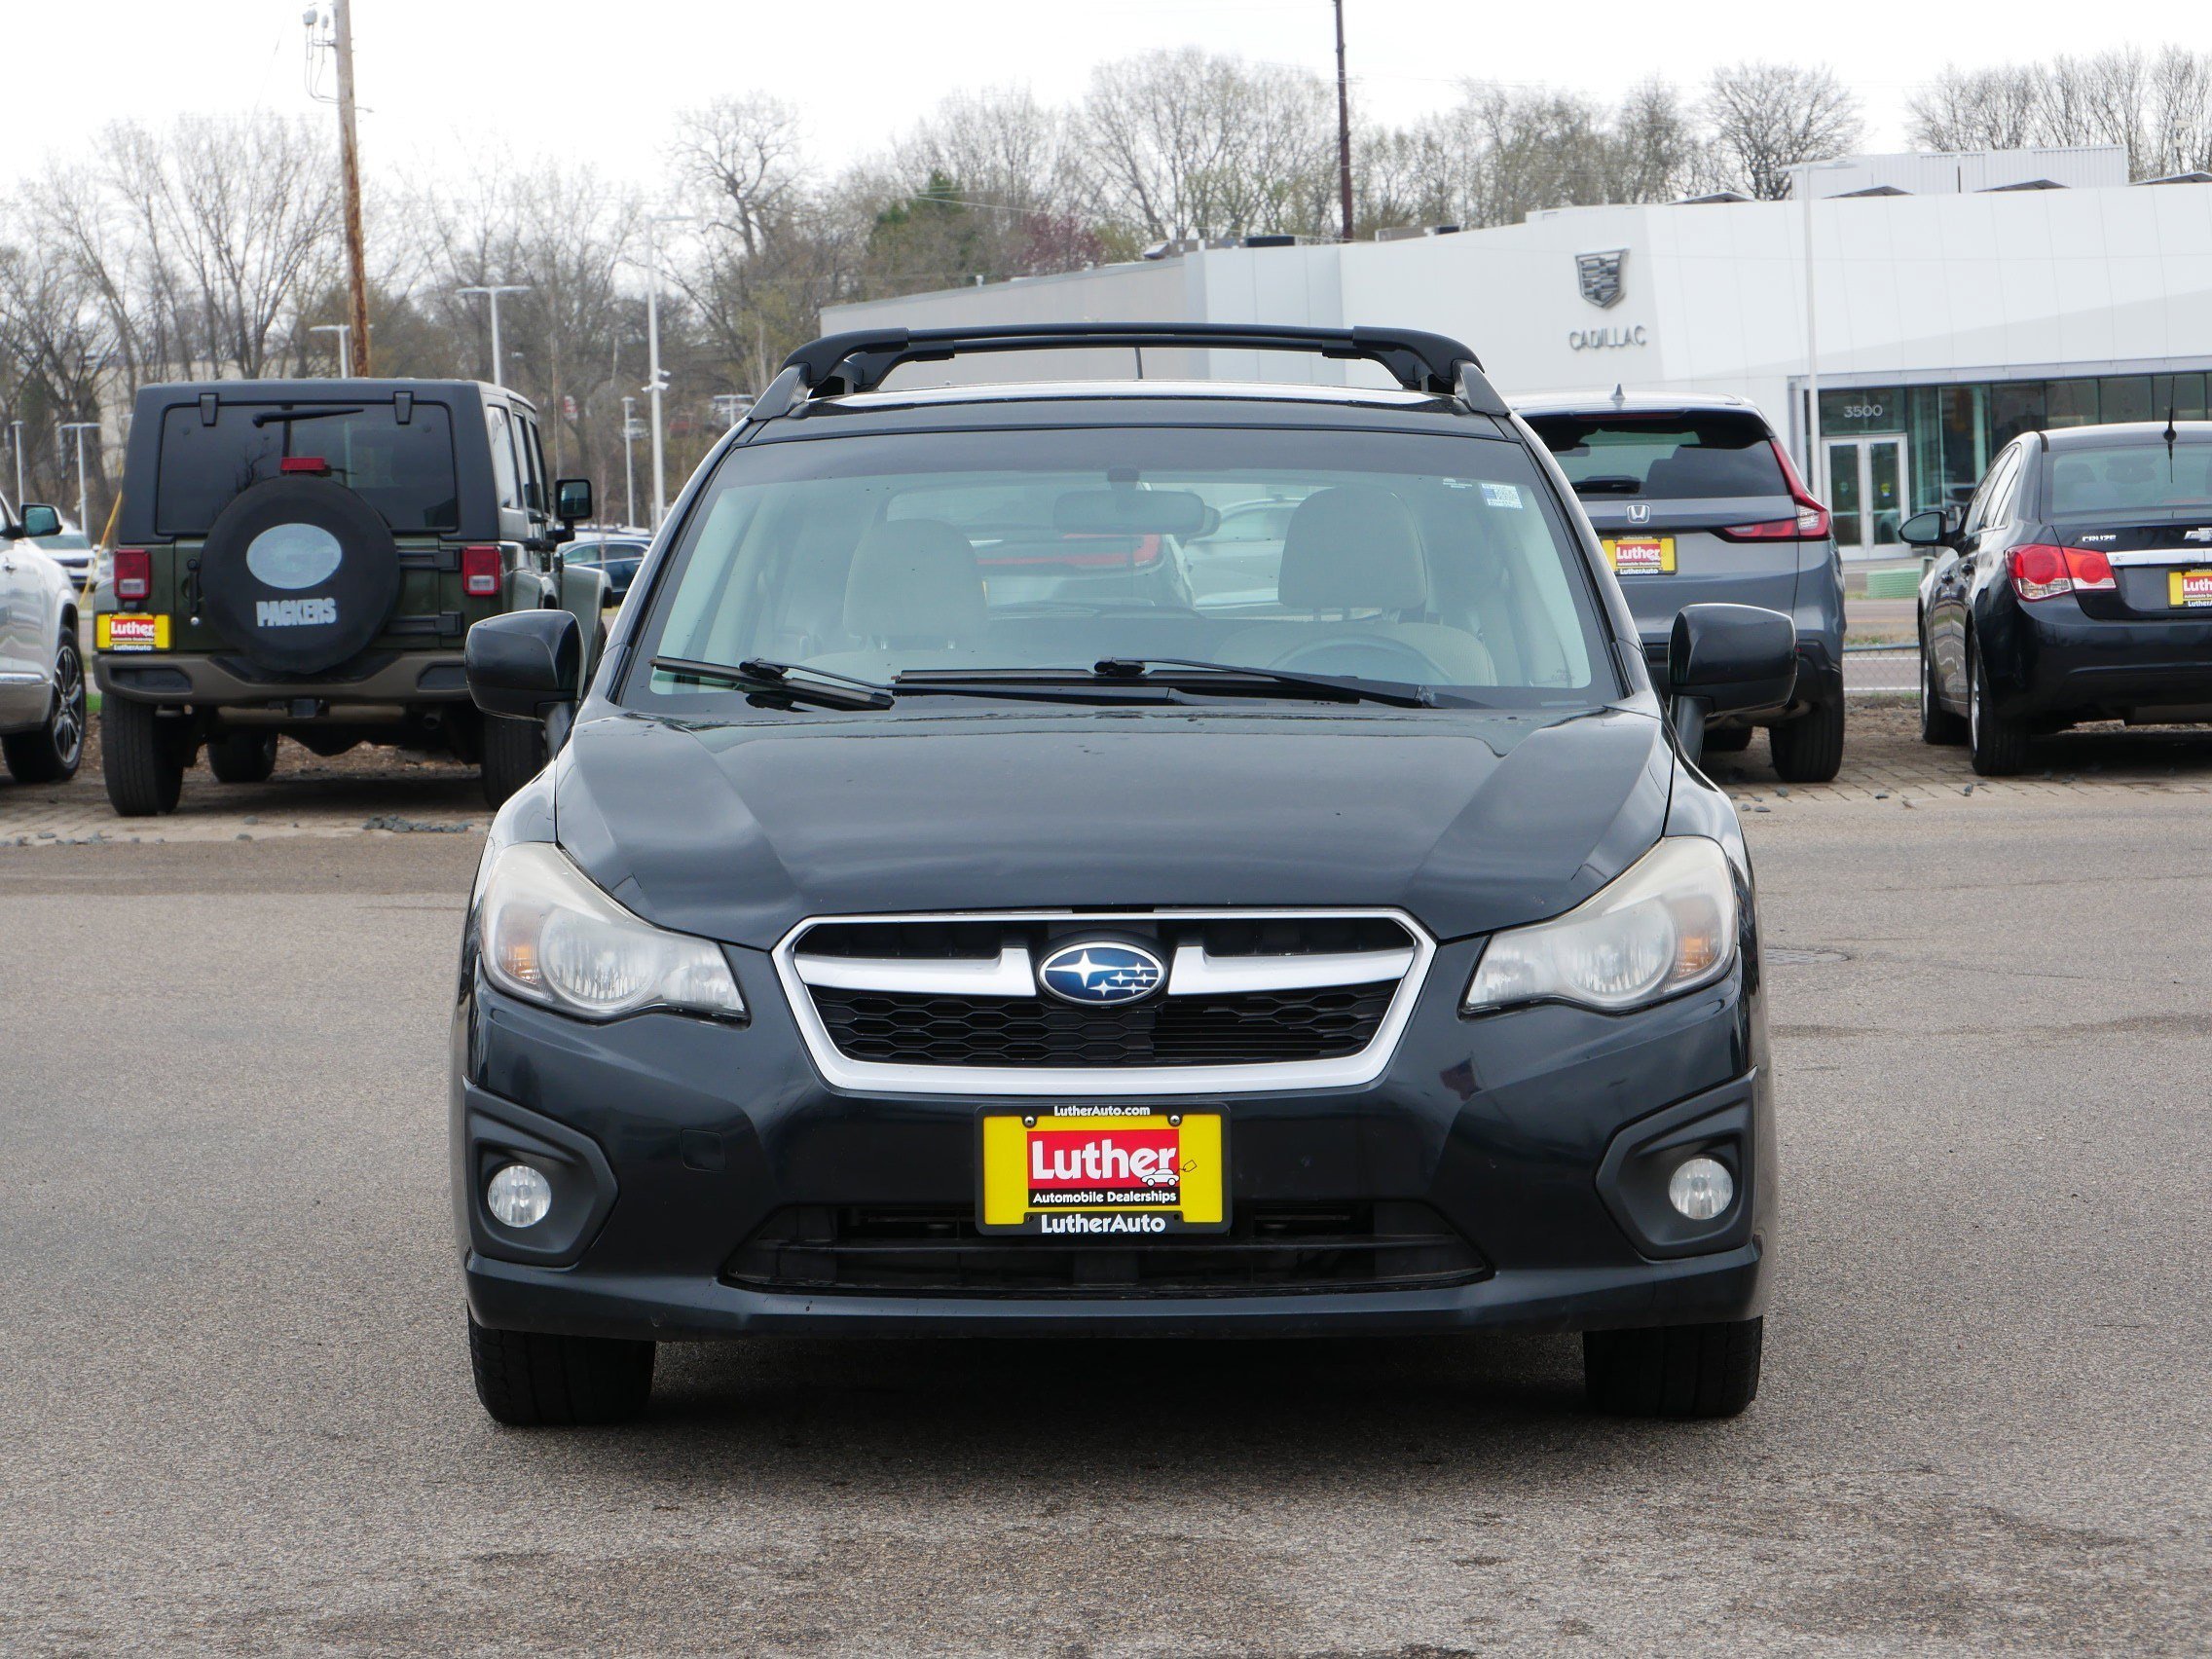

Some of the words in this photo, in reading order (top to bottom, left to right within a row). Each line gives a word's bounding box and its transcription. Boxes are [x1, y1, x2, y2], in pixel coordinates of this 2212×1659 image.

[1568, 324, 1646, 350] CADILLAC
[1843, 404, 1883, 418] 3500
[1616, 546, 1661, 560] Luther
[256, 597, 337, 627] PACKERS
[110, 621, 155, 636] Luther
[1053, 1105, 1151, 1117] LutherAuto.com
[1032, 1138, 1177, 1180] Luther
[1032, 1191, 1104, 1203] Automobile
[1107, 1190, 1177, 1204] Dealerships
[1041, 1213, 1166, 1234] LutherAuto
